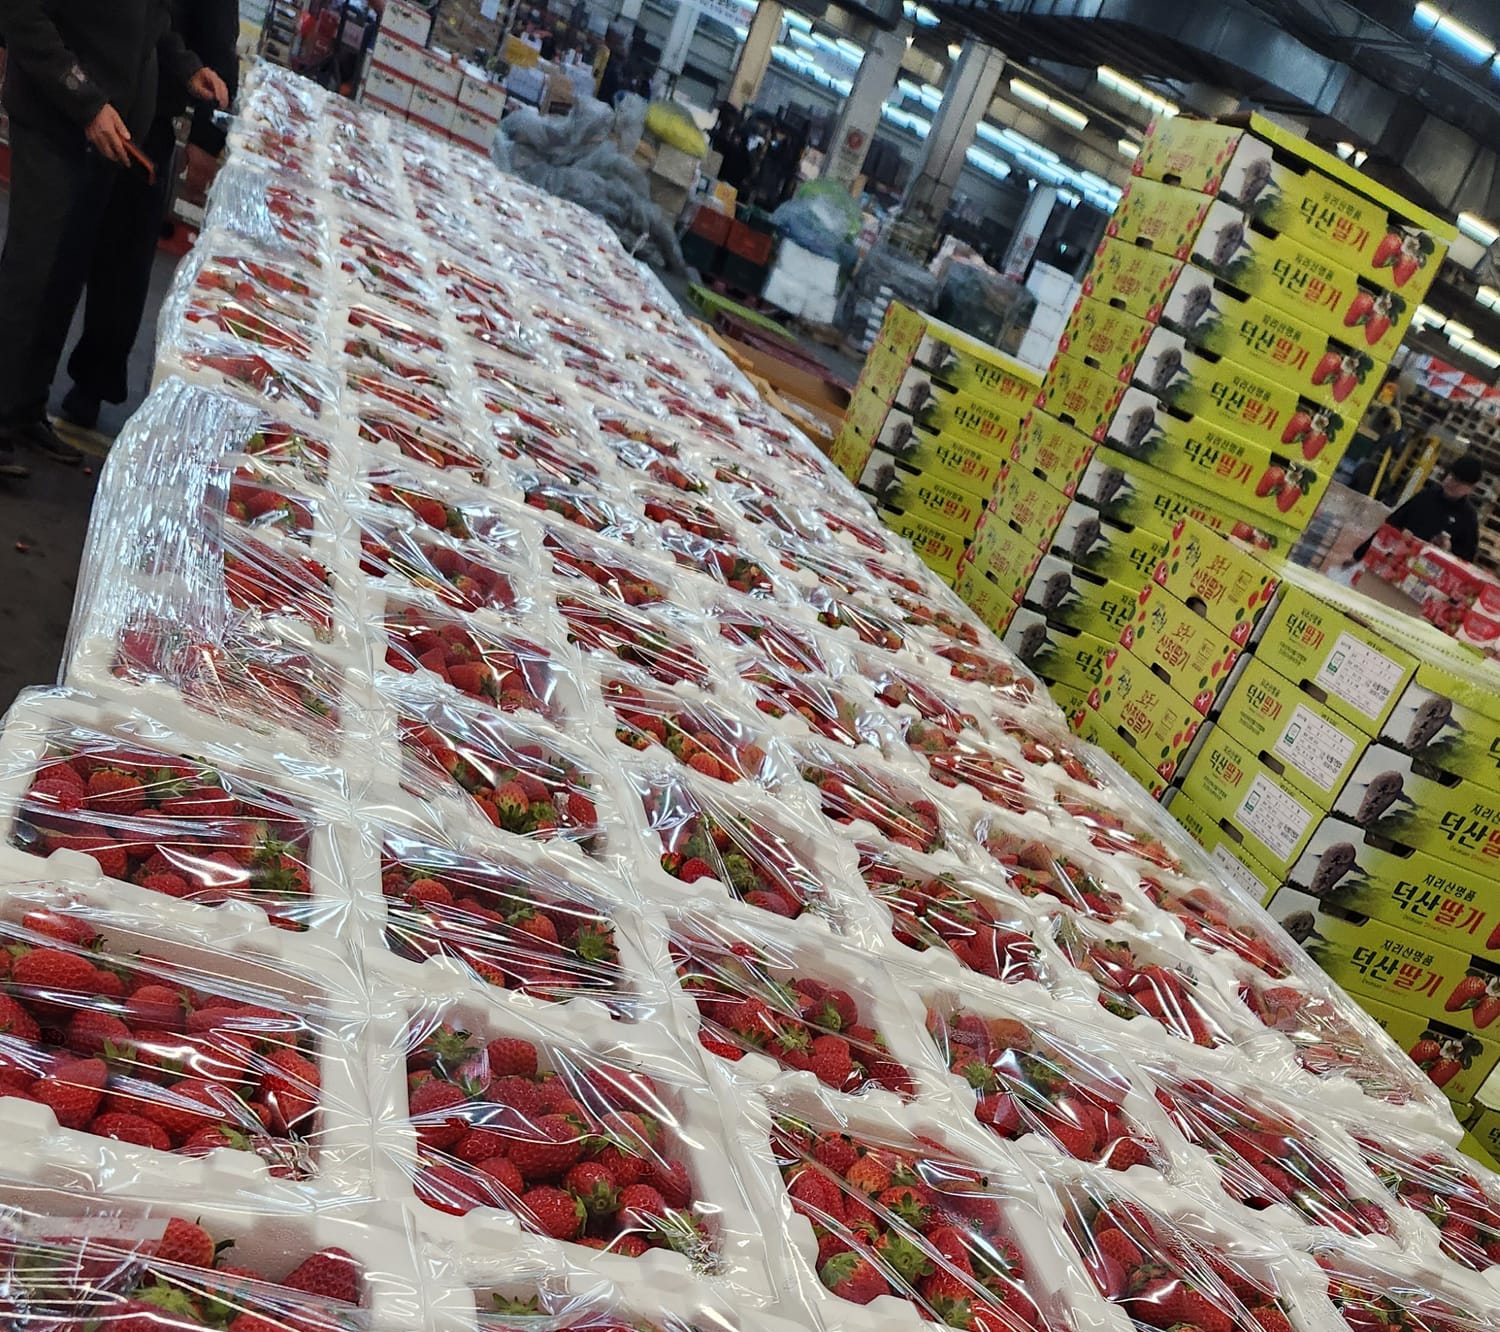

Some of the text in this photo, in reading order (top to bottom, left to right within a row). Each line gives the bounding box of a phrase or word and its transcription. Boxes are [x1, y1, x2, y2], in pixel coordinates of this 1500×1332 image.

[1300, 197, 1369, 252] 덕산딸기
[1272, 259, 1342, 312] 덕산딸기
[1240, 320, 1310, 370] 덕산딸기
[1210, 381, 1279, 430] 덕산딸기
[1184, 438, 1253, 484] 덕산딸기
[1438, 811, 1500, 859] 덕산딸
[1392, 881, 1486, 935] 덕산딸기
[1350, 946, 1444, 998] 덕산딸기
